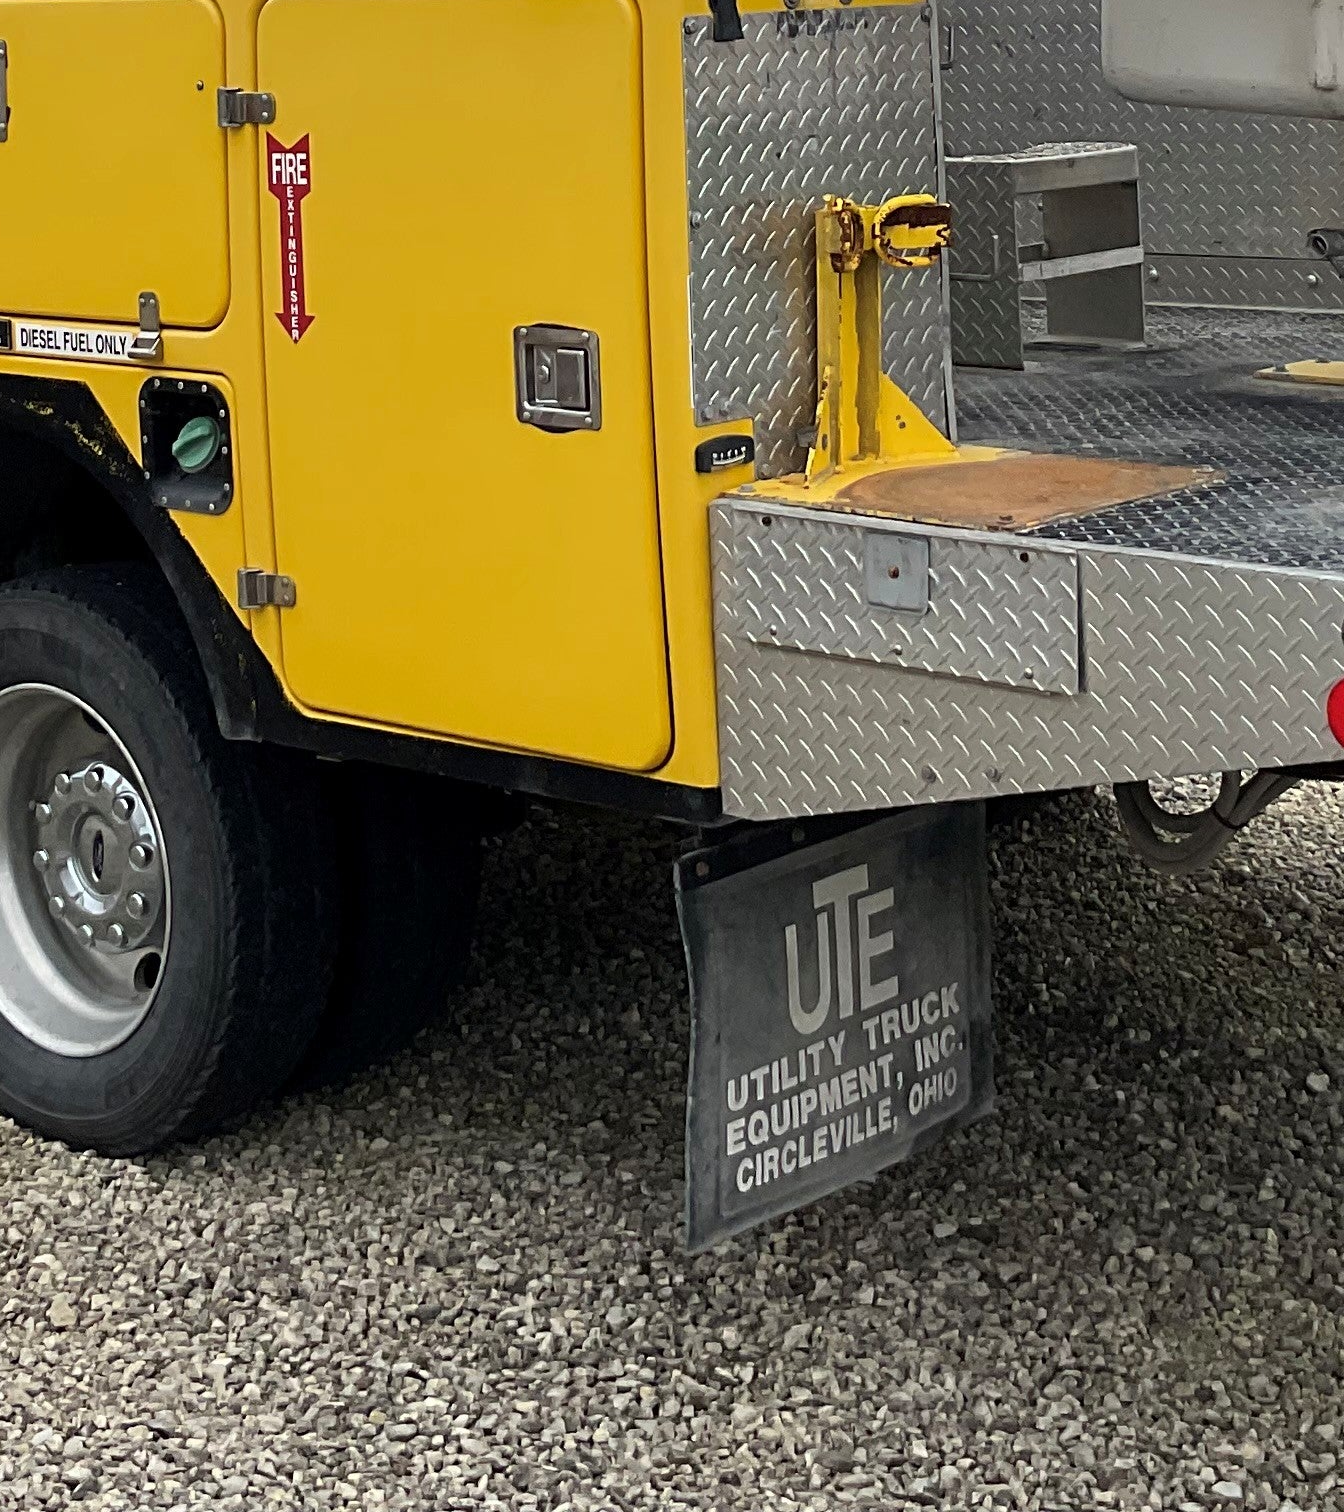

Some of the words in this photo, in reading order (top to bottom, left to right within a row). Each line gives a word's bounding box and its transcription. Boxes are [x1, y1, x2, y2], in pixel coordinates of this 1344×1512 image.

[271, 152, 308, 185] FIRE
[286, 185, 300, 341] EXTINGUISHER
[20, 327, 61, 350] DIESEL
[63, 330, 93, 353] FUEL
[95, 334, 128, 356] ONLY
[785, 863, 899, 1035] UTE
[726, 1052, 904, 1156] EQUIPMENT,
[914, 1024, 964, 1072] INC.
[727, 1029, 846, 1112] UTILITY
[861, 982, 960, 1051] TRUCK
[736, 1096, 899, 1193] CIRCLEVILLE,
[908, 1066, 957, 1116] OHIO
